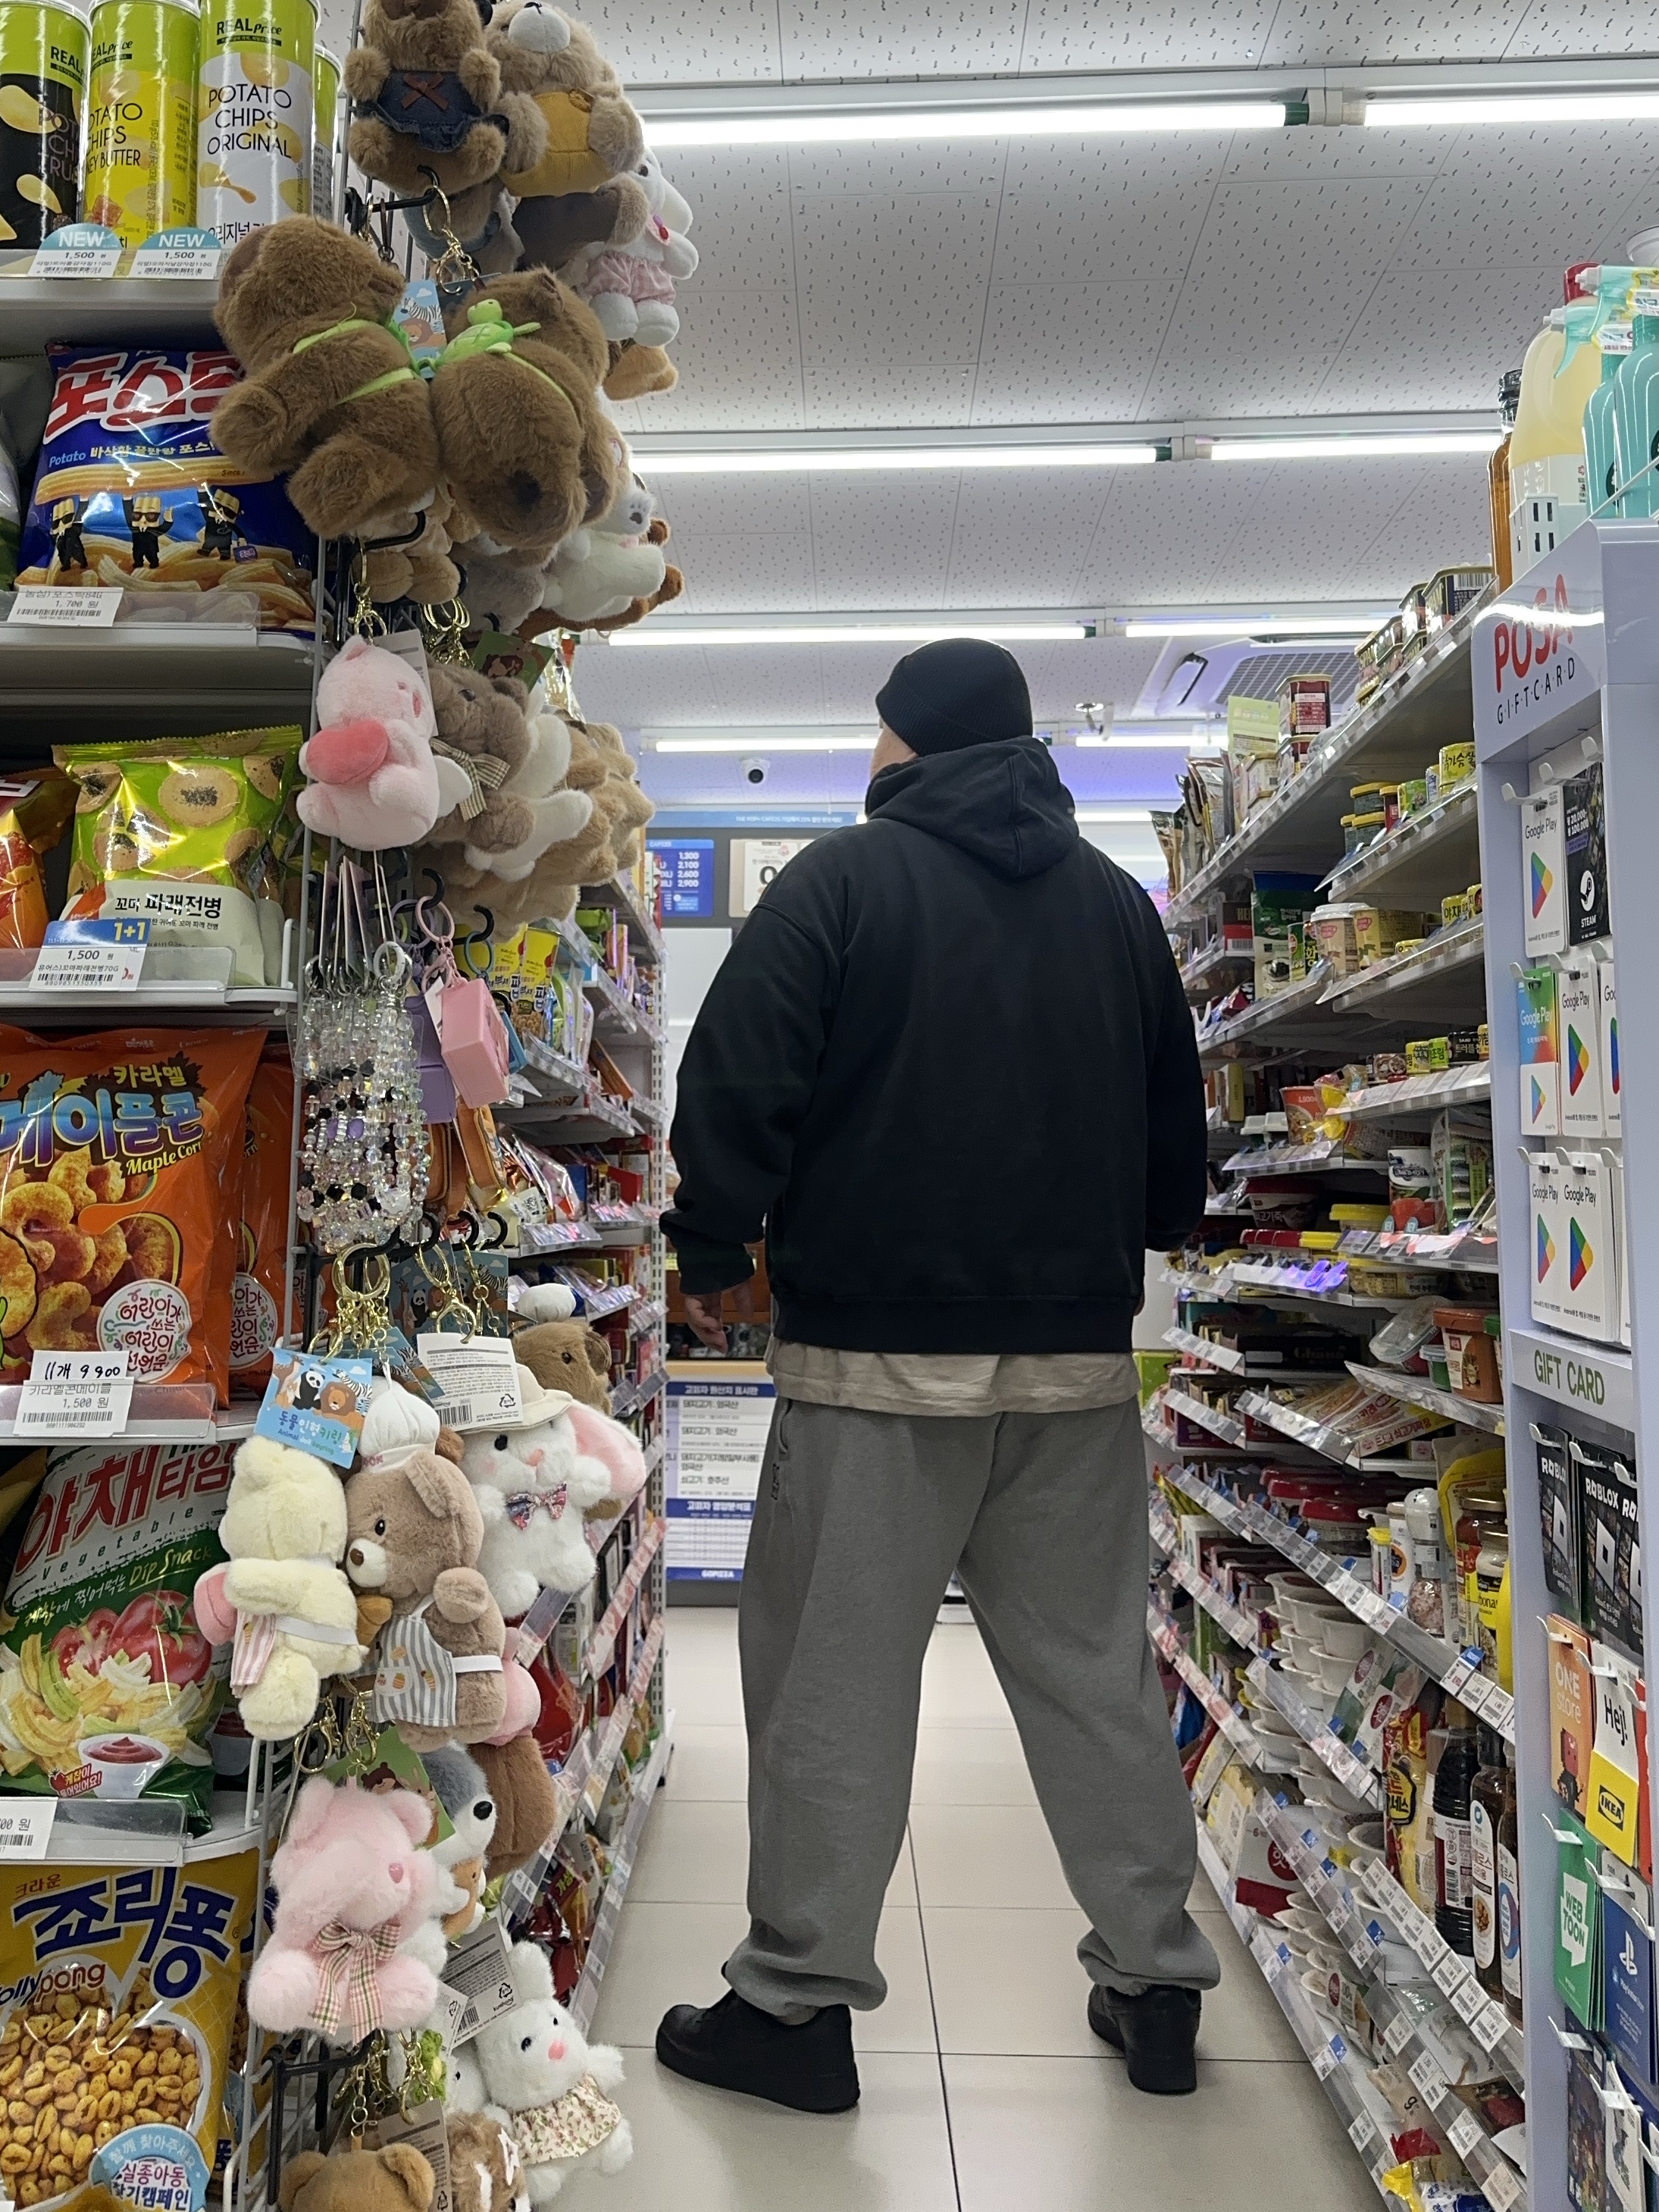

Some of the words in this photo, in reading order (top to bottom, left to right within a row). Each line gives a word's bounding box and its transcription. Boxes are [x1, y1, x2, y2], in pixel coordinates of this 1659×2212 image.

[253, 23, 282, 35] Prce
[208, 83, 292, 108] POTATO
[214, 108, 279, 130] CHIPS
[207, 132, 293, 159] ORIGINAL
[100, 149, 141, 169] BUTTER
[58, 231, 105, 247] NEW
[158, 233, 206, 248] NEW
[64, 252, 95, 260] 1,500
[164, 252, 195, 260] 1,500
[179, 441, 215, 455] 포스
[49, 452, 86, 468] Potato
[55, 600, 83, 608] 1,700
[87, 600, 99, 609] 원
[1525, 820, 1545, 840] Google
[1545, 817, 1557, 834] Play
[114, 897, 140, 912] 꼬마
[145, 893, 222, 919] 파래전병
[114, 922, 146, 942] 1+1
[1581, 914, 1597, 929] STEAM
[67, 950, 100, 960] 1,500
[1562, 992, 1579, 1012] Google
[1579, 990, 1590, 1010] Play
[1520, 1007, 1540, 1029] Google
[1540, 1006, 1552, 1025] Play
[114, 1063, 187, 1089] 카라멜
[0, 1088, 204, 1168] 메이플콘
[126, 1146, 176, 1176] Maple
[1532, 1183, 1548, 1204] Google
[1548, 1184, 1559, 1204] Play
[1564, 1183, 1584, 1206] Google
[1584, 1186, 1597, 1208] Play
[120, 1294, 182, 1322] 어린이가
[151, 1317, 175, 1331] 쓰는
[124, 1330, 174, 1353] 어린이
[1533, 1349, 1562, 1390] GIFT
[1567, 1360, 1605, 1406] CARD
[63, 1397, 92, 1408] 1,500
[97, 1397, 109, 1408] 원
[277, 1428, 299, 1441] Animal
[279, 1411, 342, 1446] 동물인형키링
[1585, 1477, 1619, 1511] ROBLOX
[42, 1506, 194, 1581] Vegetable
[1555, 1661, 1580, 1699] ONE
[1556, 1689, 1582, 1725] store
[1604, 1694, 1629, 1747] Hej!
[1601, 1792, 1623, 1822] IKEA
[18, 1818, 31, 1831] 원
[14, 1872, 62, 1899] 크라운
[1564, 1890, 1583, 1917] WEB
[12, 1866, 239, 2000] 죠리퐁
[1562, 1907, 1586, 1948] TOON
[122, 2163, 186, 2188] 실종아동
